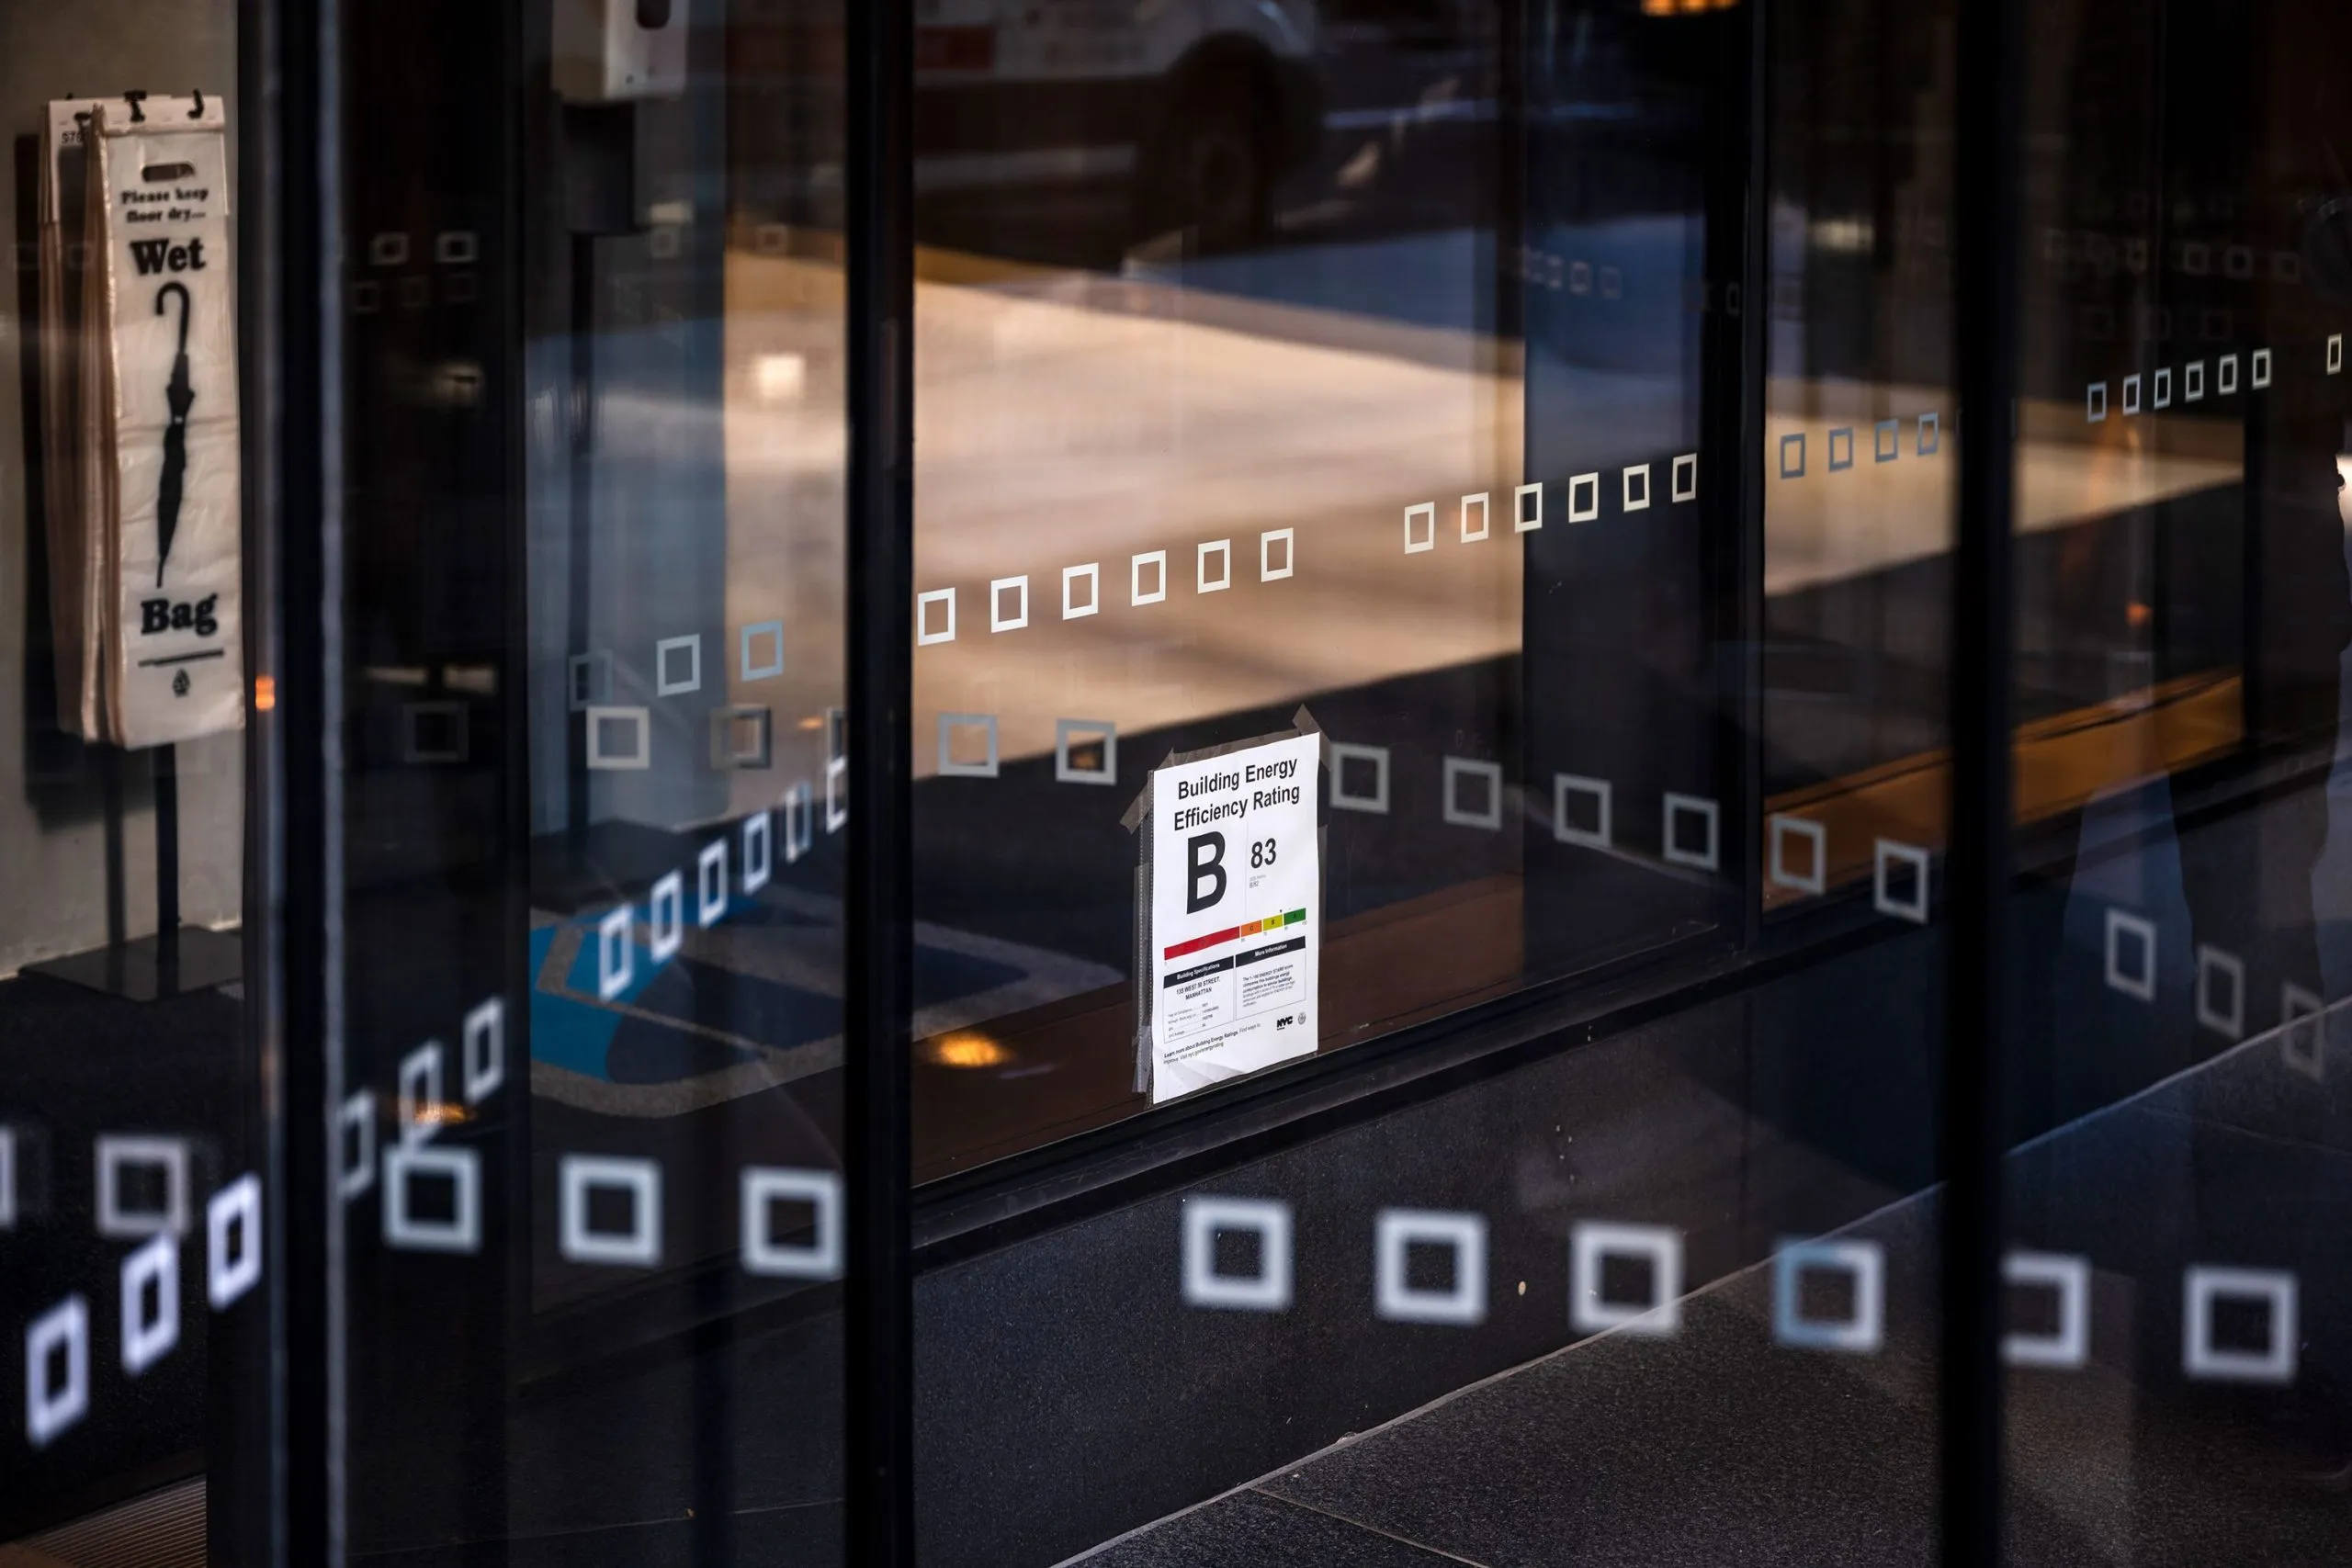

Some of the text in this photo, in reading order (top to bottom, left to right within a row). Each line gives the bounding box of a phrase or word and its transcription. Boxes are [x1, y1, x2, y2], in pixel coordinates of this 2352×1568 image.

[121, 186, 209, 204] Please keep
[126, 209, 163, 223] floor
[130, 237, 206, 276] Wet
[140, 592, 218, 637] Bag
[1178, 758, 1297, 800] Building Energy
[1174, 785, 1300, 831] Efficiency Rating
[1250, 838, 1276, 869] 83
[1186, 830, 1227, 914] B
[1254, 943, 1287, 956] More Information
[1176, 963, 1220, 980] Building Specifications
[1184, 983, 1197, 993] WEST
[1185, 987, 1212, 1000] MANHATTAN
[1276, 1015, 1293, 1028] NYC
[1184, 1043, 1195, 1052] about
[1195, 1039, 1211, 1048] Building
[1210, 1034, 1224, 1043] Energy
